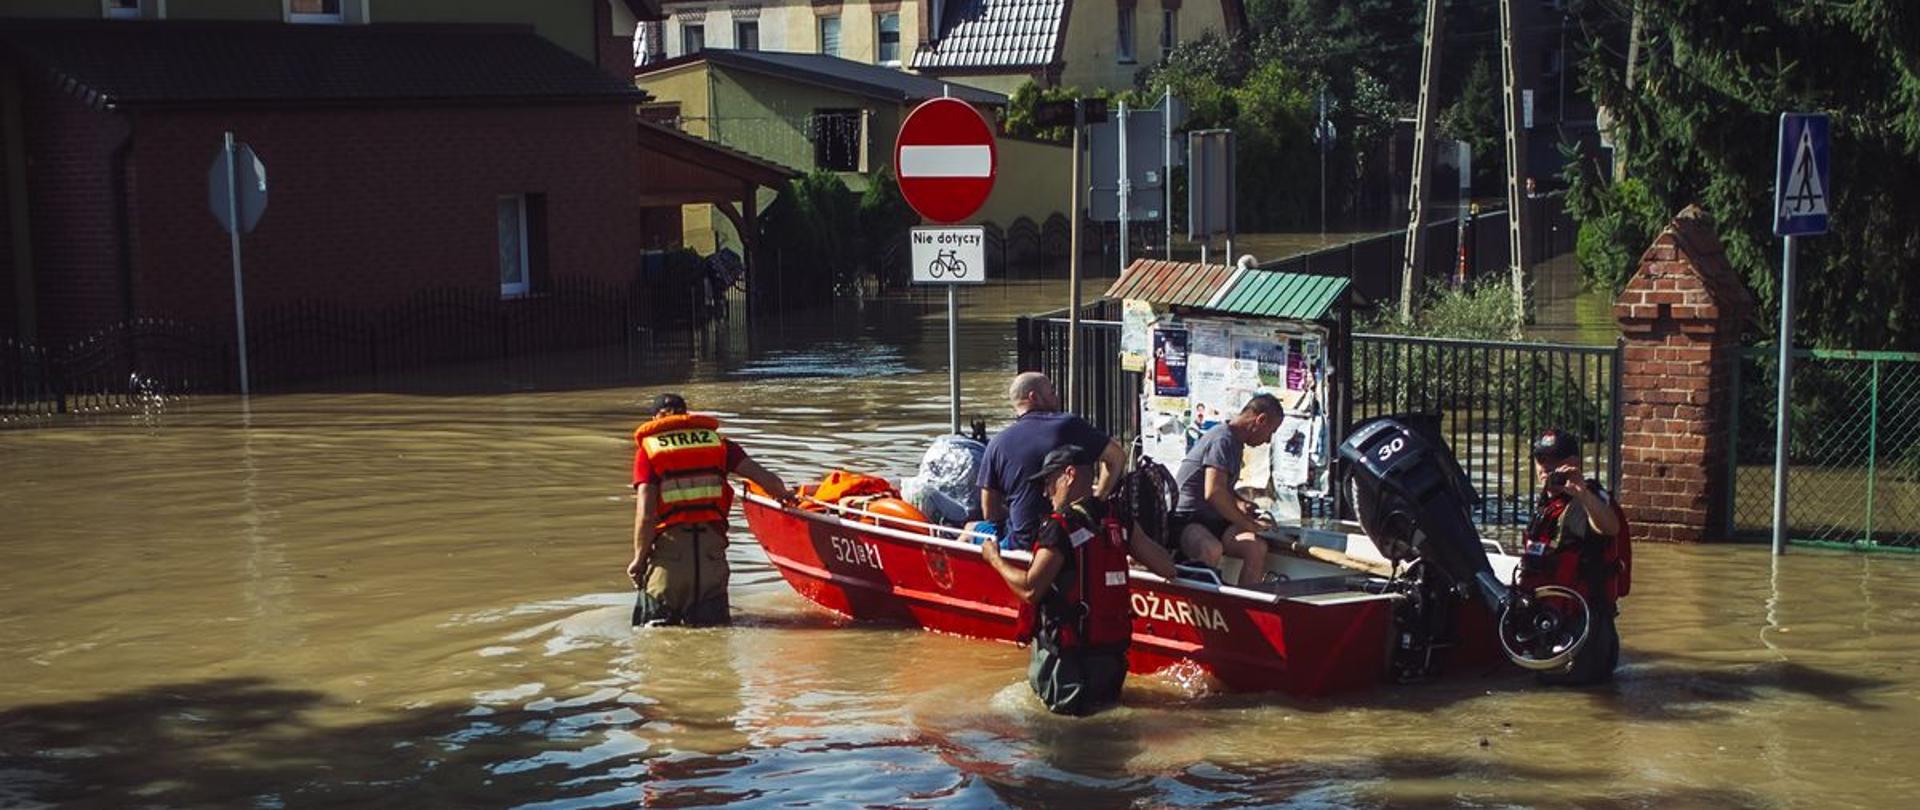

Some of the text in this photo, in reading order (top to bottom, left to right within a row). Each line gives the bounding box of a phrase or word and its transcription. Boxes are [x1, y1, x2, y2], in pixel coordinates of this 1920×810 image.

[913, 232, 981, 246] Nie dotyczy
[1377, 437, 1404, 461] 30
[1130, 591, 1230, 633] OŻARNA
